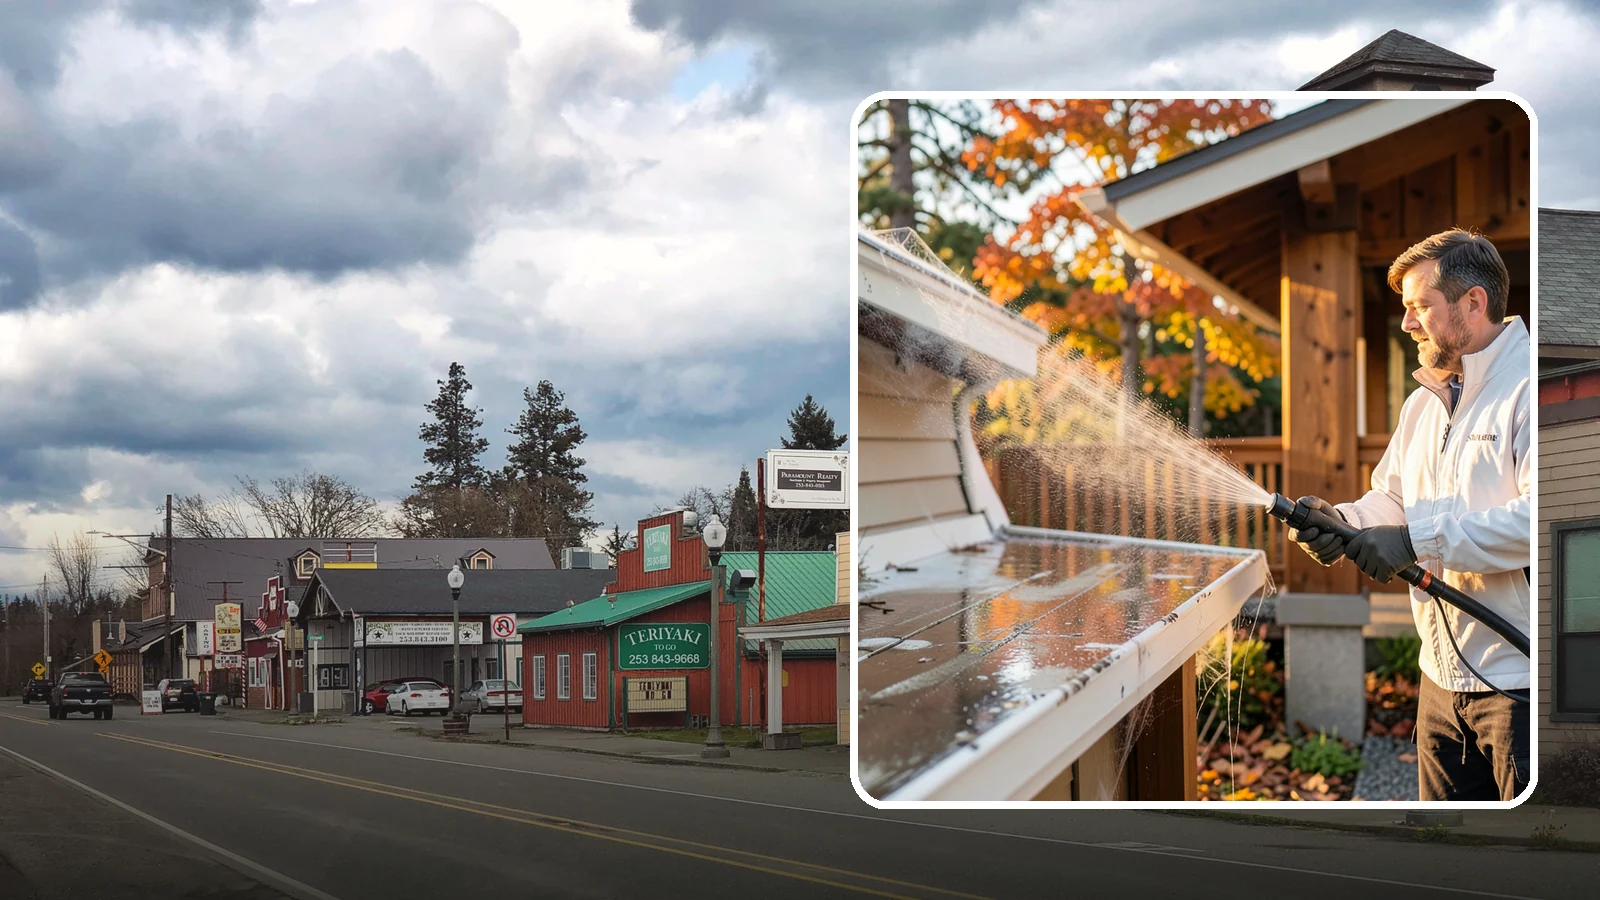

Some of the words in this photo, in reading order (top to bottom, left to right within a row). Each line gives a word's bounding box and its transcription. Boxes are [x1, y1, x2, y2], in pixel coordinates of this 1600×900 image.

[624, 627, 702, 646] TERIYAKI
[653, 643, 664, 651] TO
[665, 643, 677, 651] GO
[628, 654, 649, 665] 253
[651, 653, 700, 664] 843-9668
[639, 681, 673, 691] TERIYAKI
